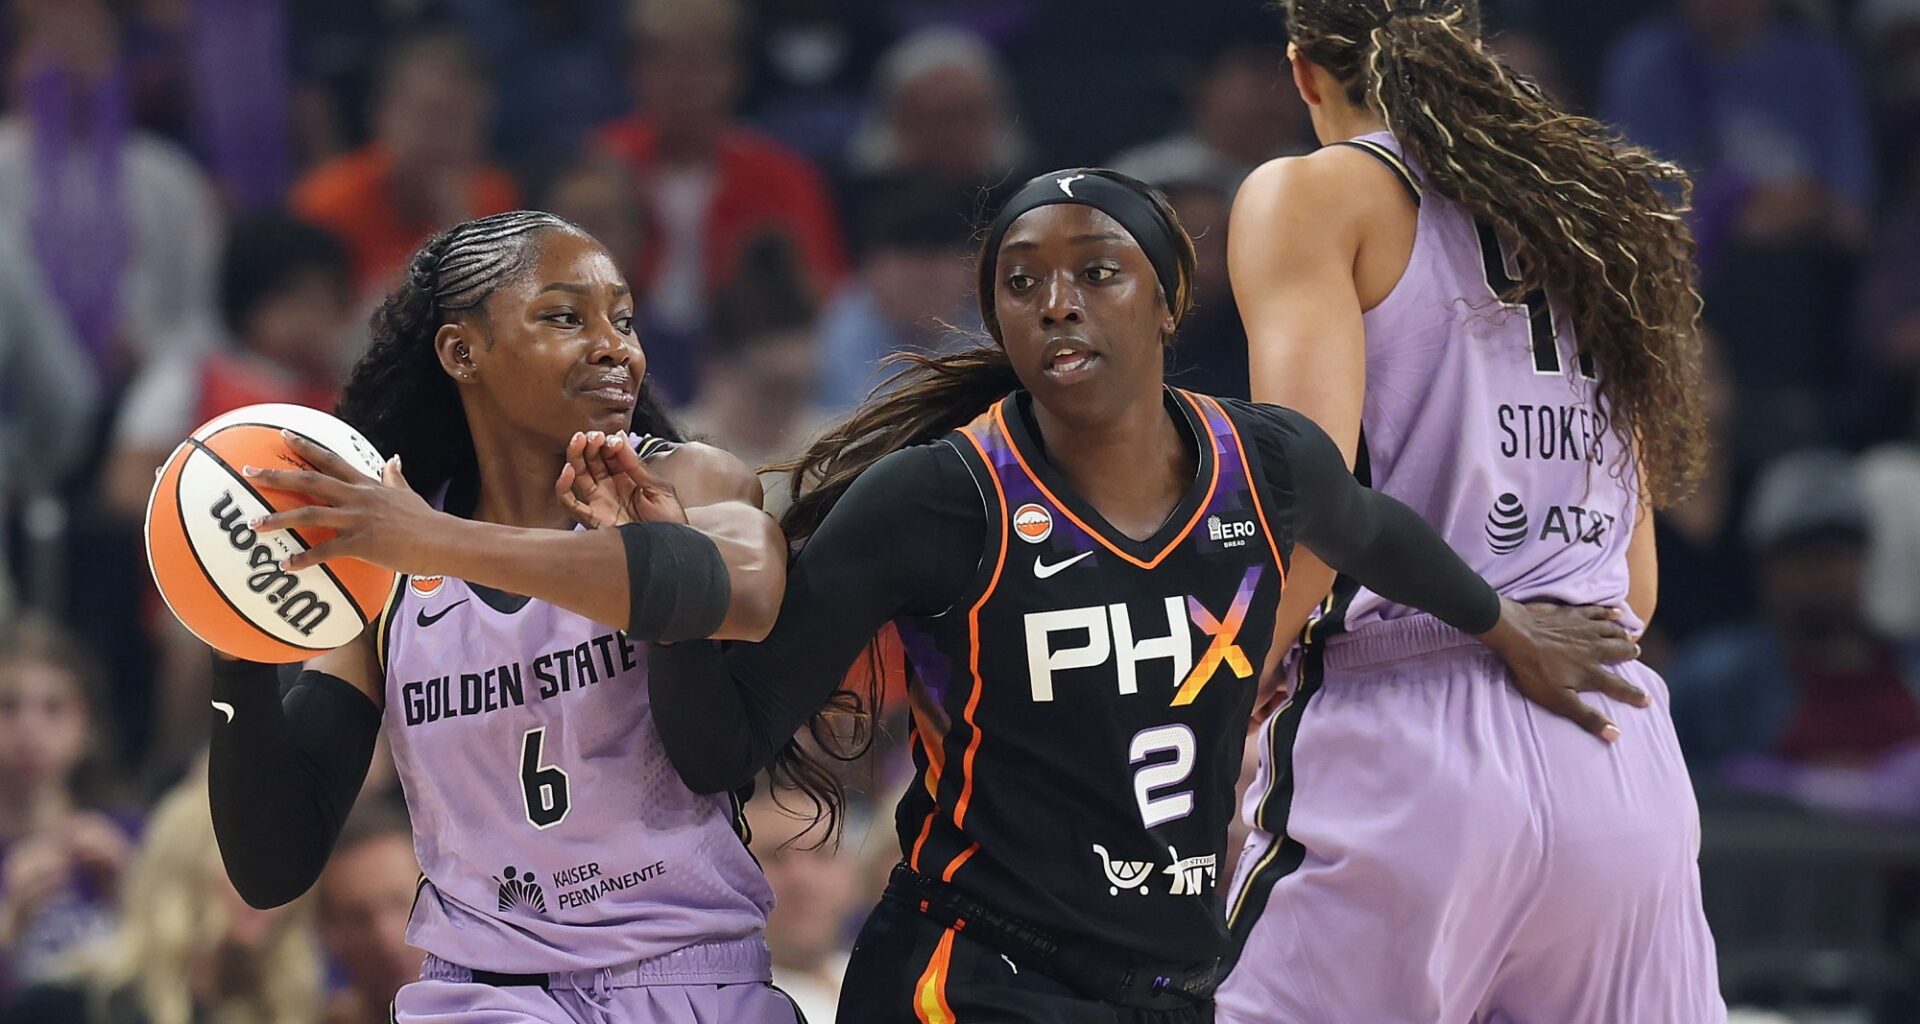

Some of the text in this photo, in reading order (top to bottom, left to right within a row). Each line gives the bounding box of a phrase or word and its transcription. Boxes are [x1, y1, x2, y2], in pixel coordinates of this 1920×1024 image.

[1498, 404, 1605, 466] STOKES
[1208, 515, 1255, 540] HERO
[1223, 540, 1246, 548] BREAD
[1539, 506, 1615, 548] AT&T
[209, 489, 332, 638] Wilson
[1024, 566, 1264, 707] PHX
[402, 629, 637, 726] GOLDEN STATE
[519, 726, 572, 831] 6
[1129, 723, 1197, 829] 2
[553, 862, 602, 889] KAISER
[558, 860, 667, 911] PERMANENTE
